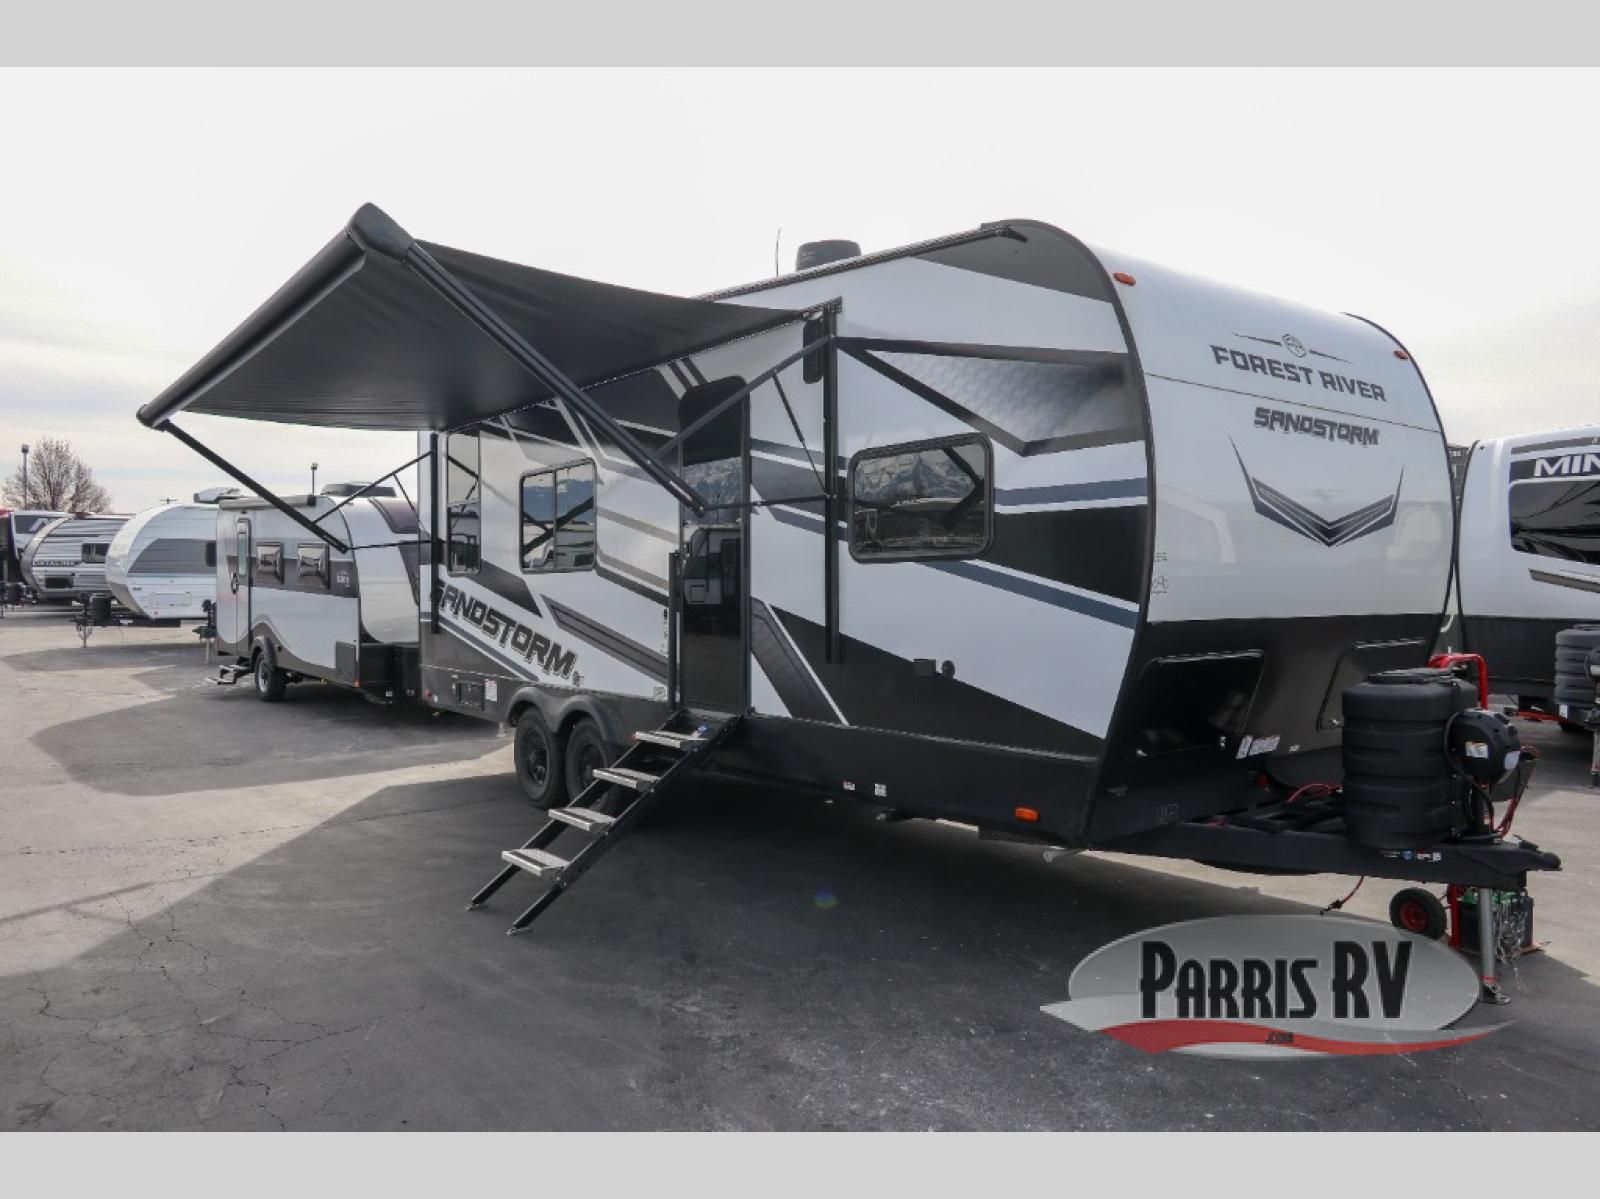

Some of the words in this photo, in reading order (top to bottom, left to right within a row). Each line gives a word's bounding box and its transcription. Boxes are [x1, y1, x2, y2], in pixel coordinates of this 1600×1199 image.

[1209, 345, 1313, 385] FOREST
[1319, 370, 1387, 402] RIVER
[1254, 407, 1380, 446] SANDSTORM
